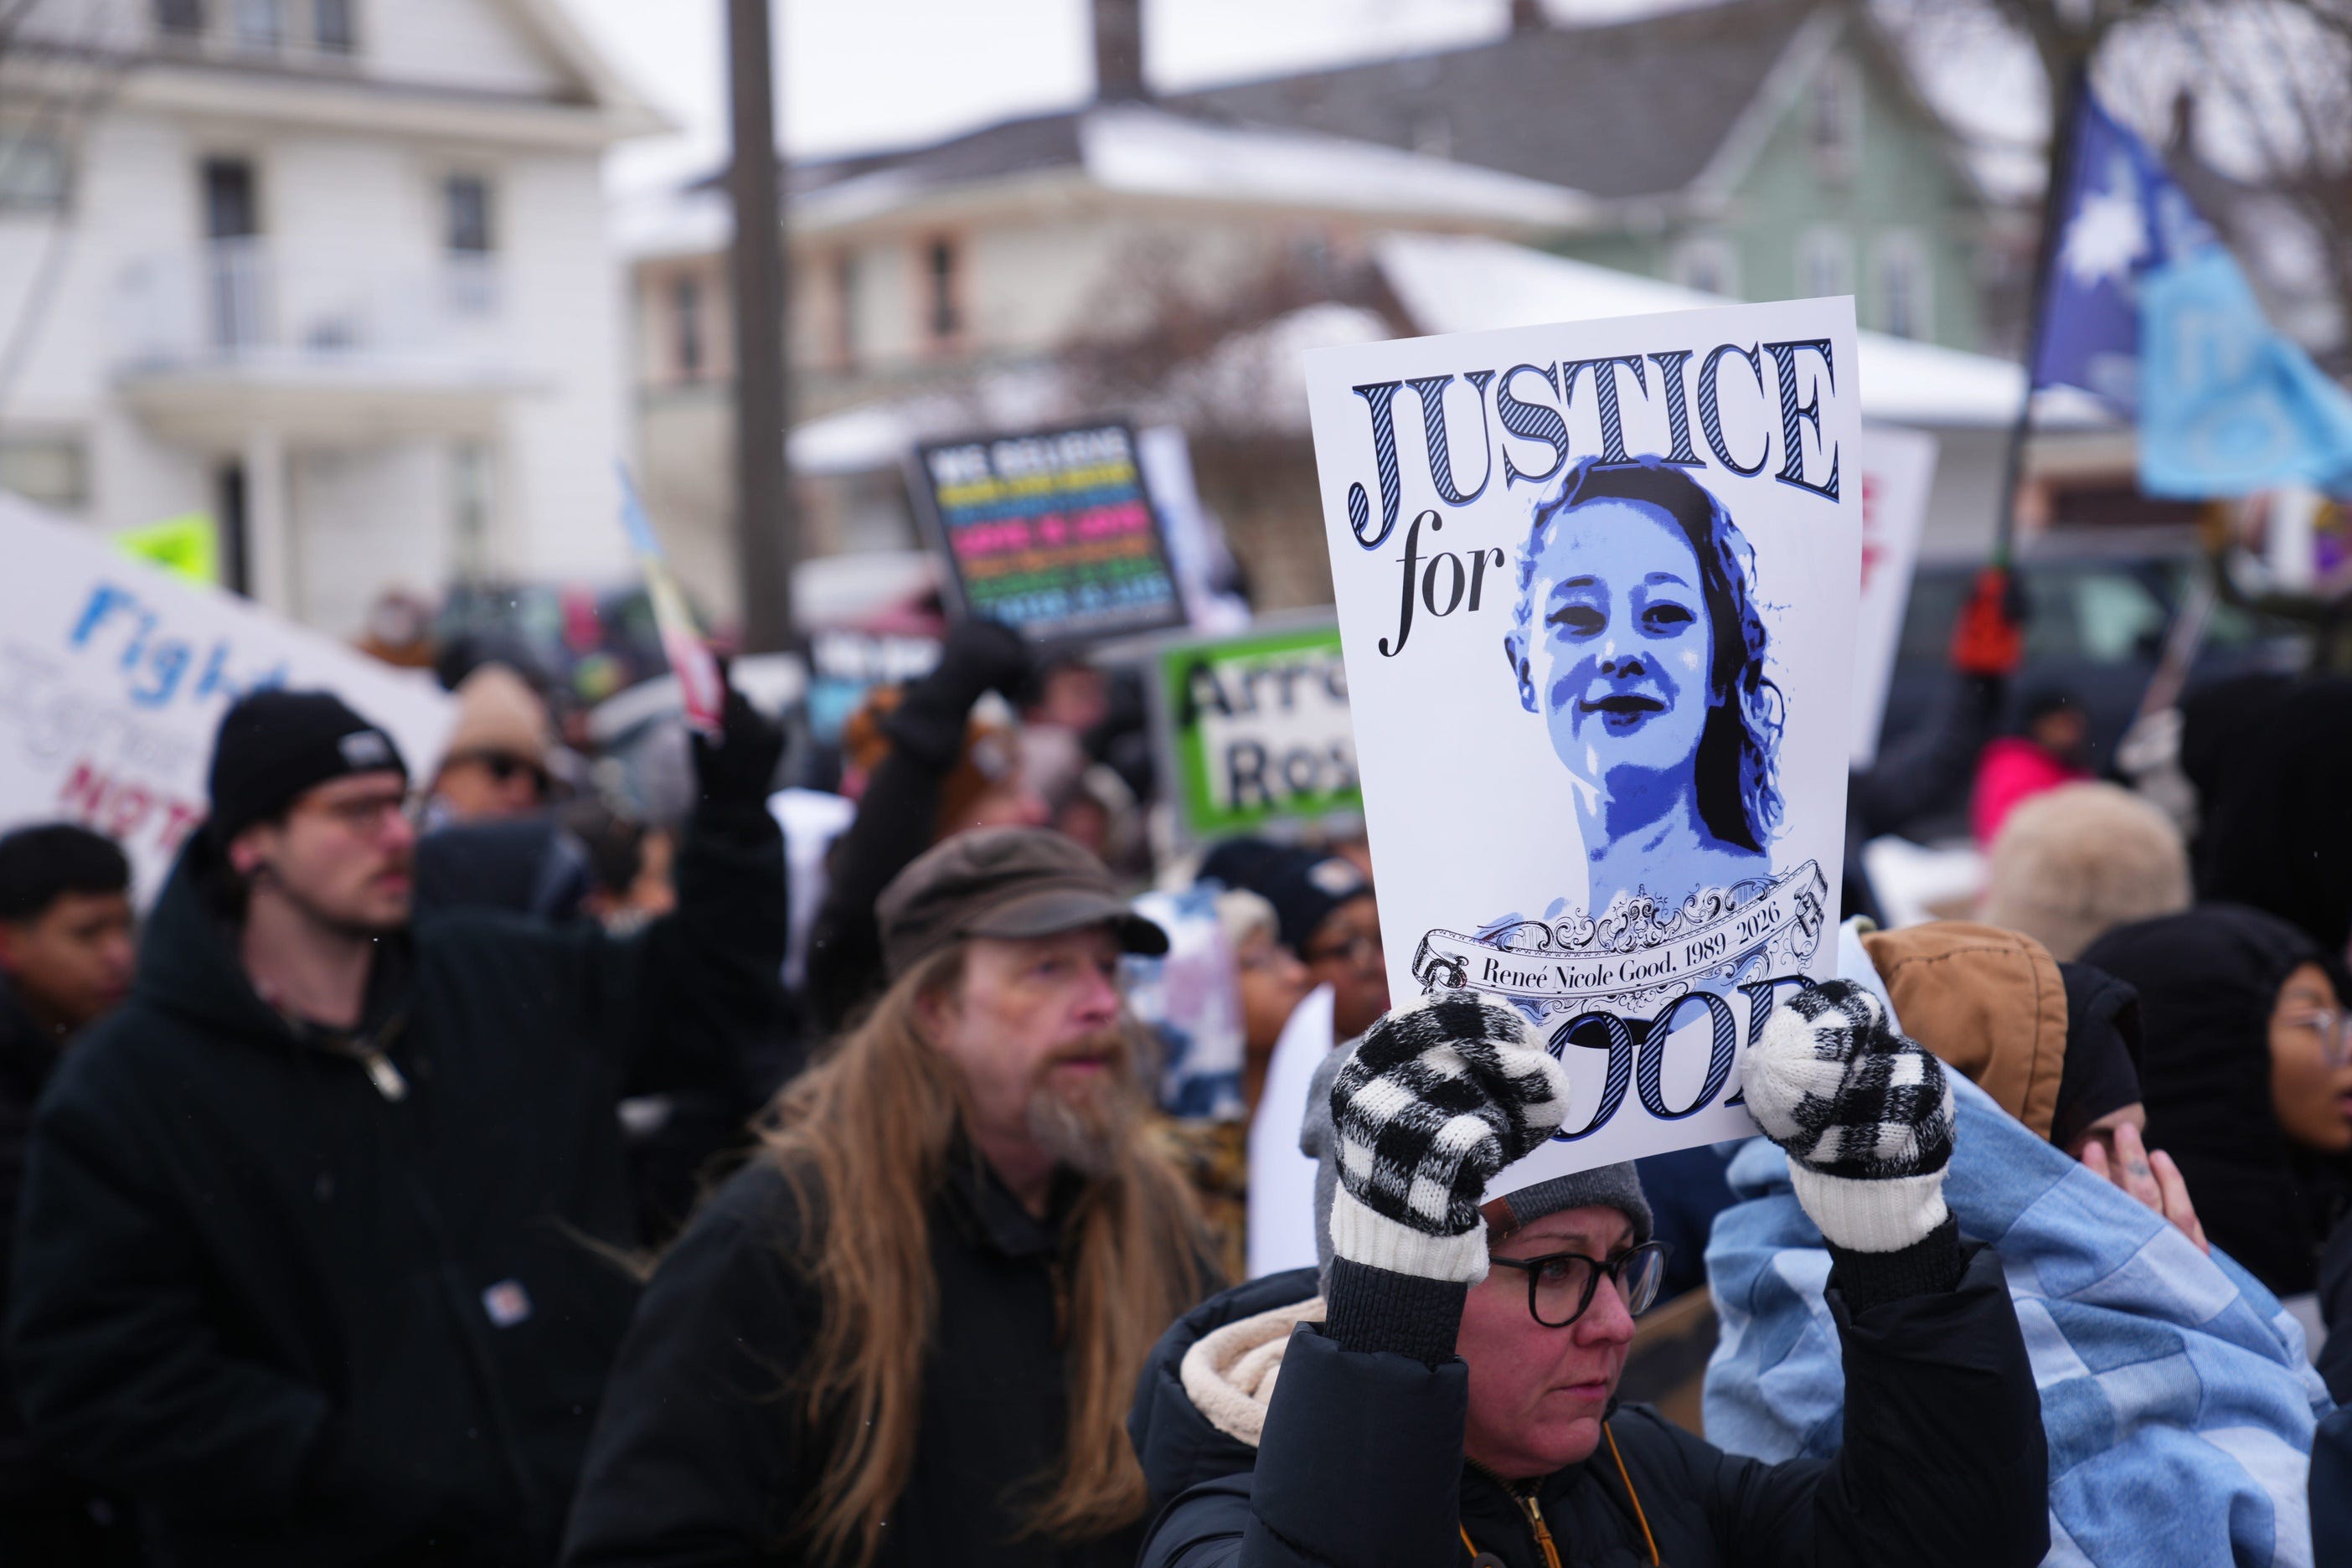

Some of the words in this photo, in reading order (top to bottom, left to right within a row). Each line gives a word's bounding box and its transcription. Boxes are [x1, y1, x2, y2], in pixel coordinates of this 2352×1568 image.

[1348, 338, 1840, 550] JUSTICE
[1379, 509, 1505, 658] for
[1482, 956, 1548, 986] Reneé
[1555, 962, 1613, 990] Nicole
[1619, 952, 1678, 985] Good,
